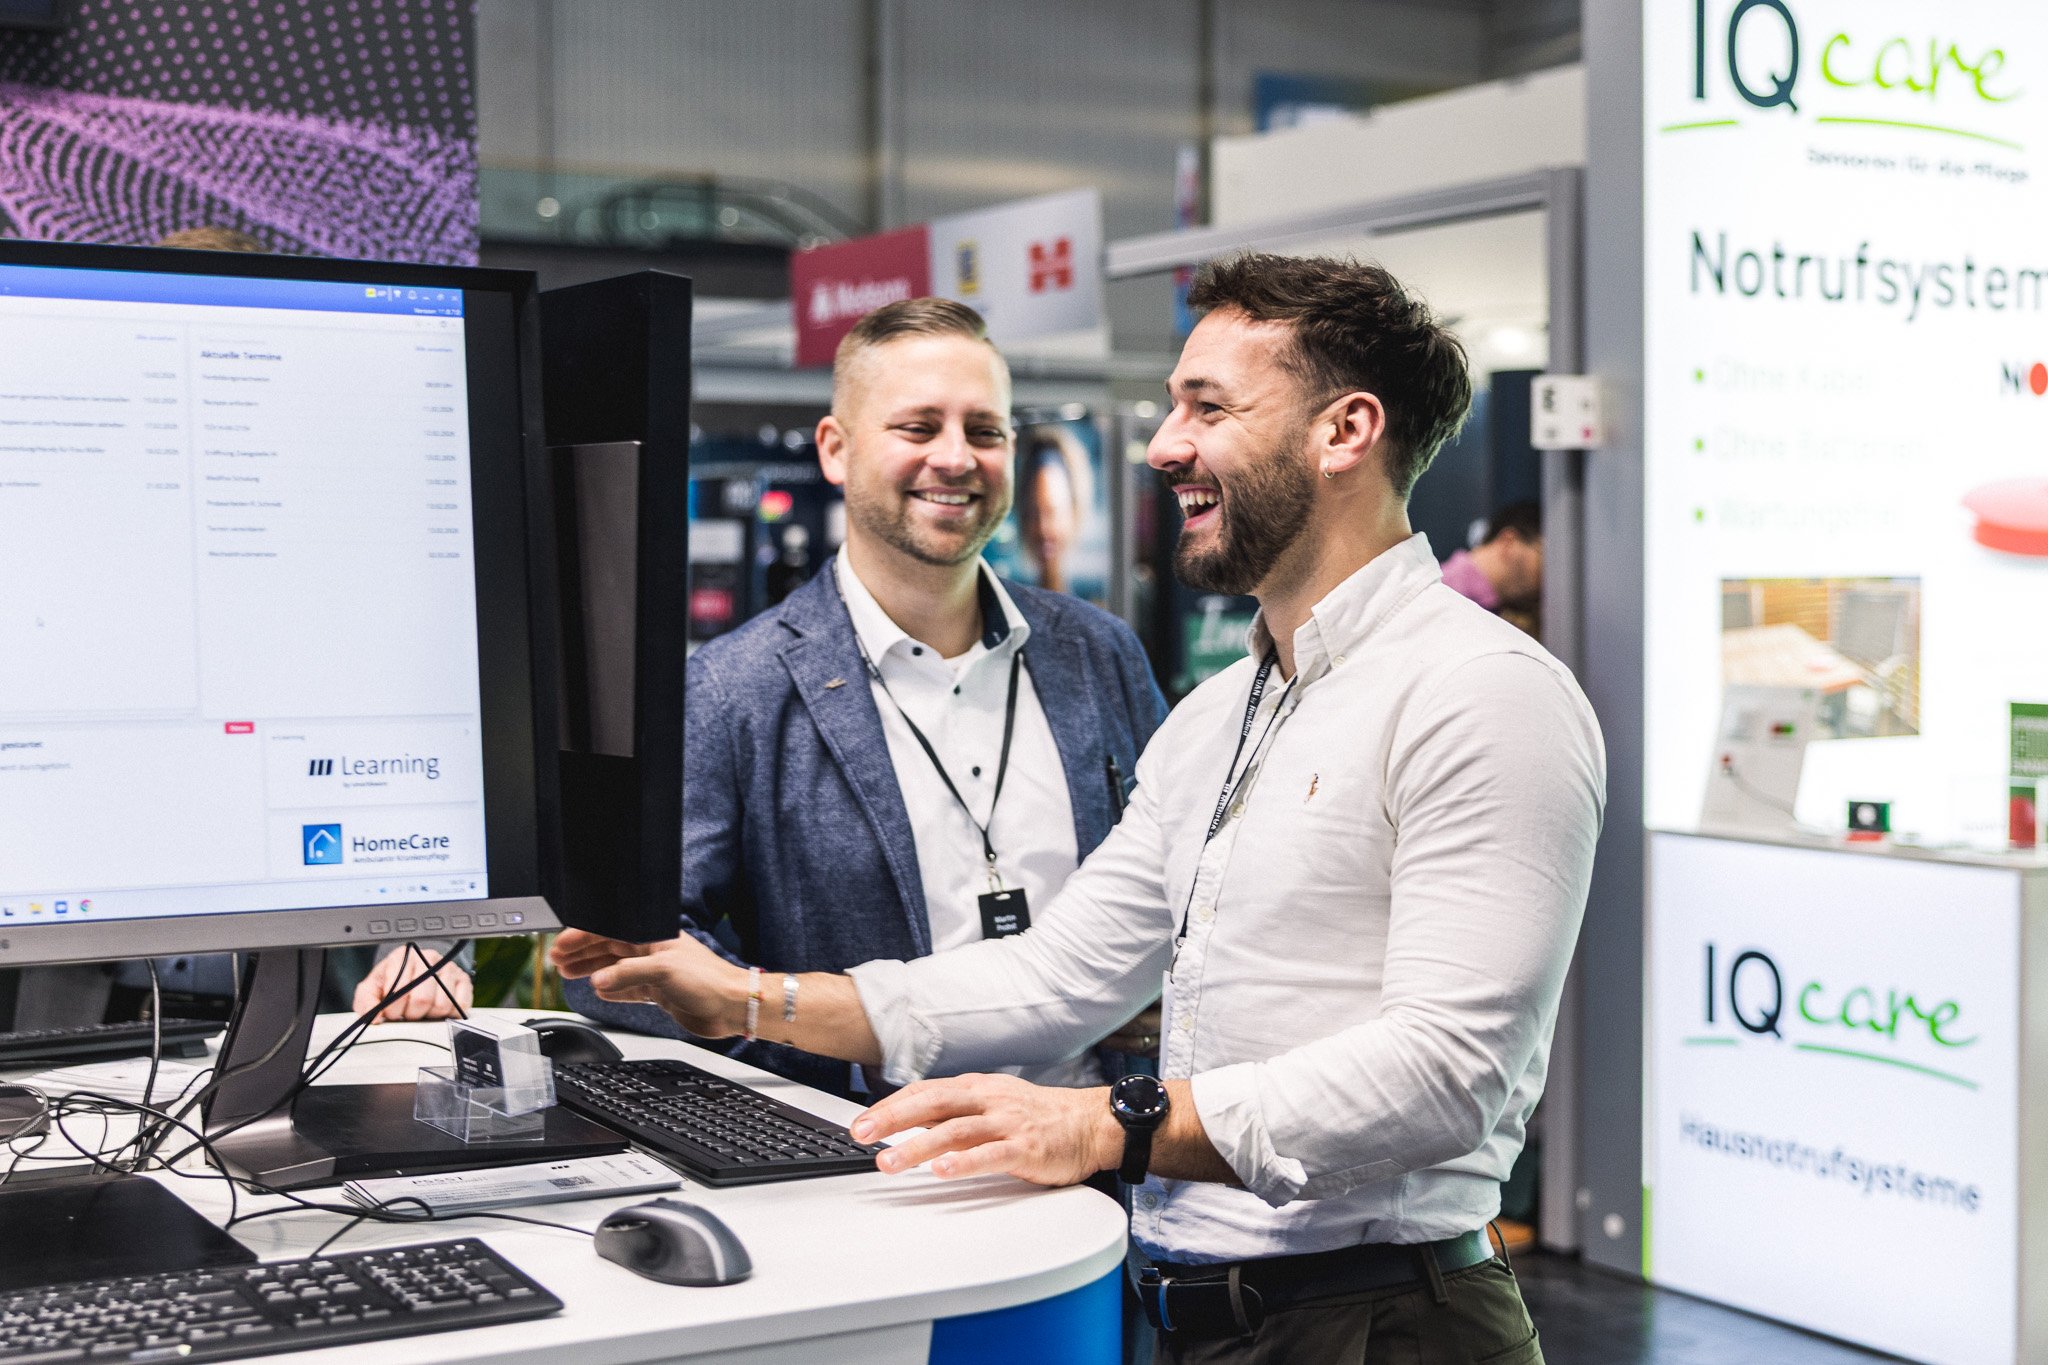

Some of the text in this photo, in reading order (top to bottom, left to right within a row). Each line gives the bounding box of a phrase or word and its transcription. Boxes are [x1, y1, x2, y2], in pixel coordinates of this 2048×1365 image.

[341, 753, 441, 780] Learning
[352, 834, 451, 852] HomeCare
[1679, 1112, 1984, 1214] Hausnotrufsysteme
